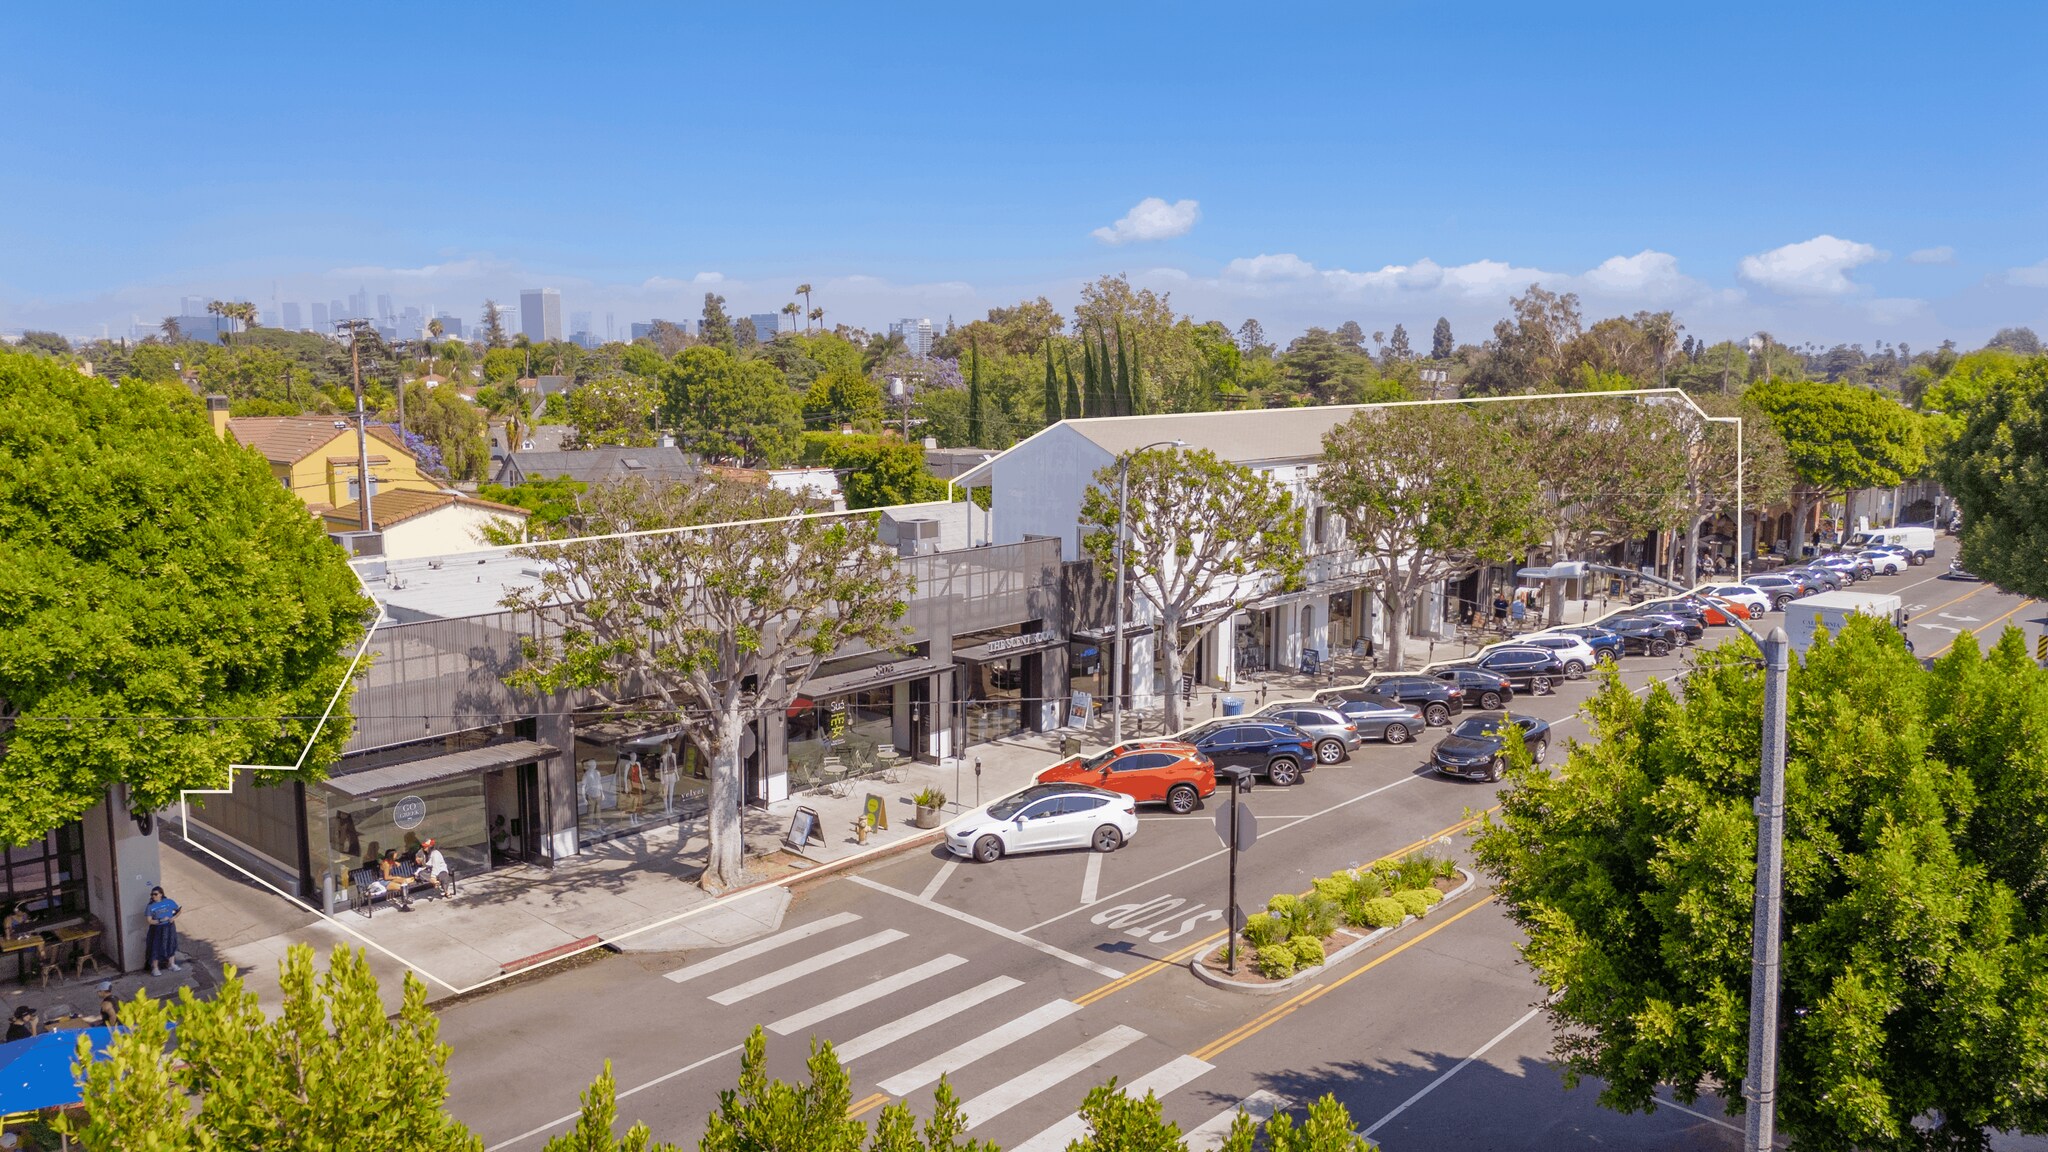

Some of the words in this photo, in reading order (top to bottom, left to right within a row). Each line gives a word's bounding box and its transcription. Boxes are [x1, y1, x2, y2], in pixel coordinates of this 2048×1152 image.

[1802, 619, 1841, 627] CALIORNIA
[988, 640, 1005, 652] THE
[1006, 634, 1030, 648] SCENT
[681, 788, 705, 799] velvet
[402, 802, 417, 812] GO
[1090, 893, 1223, 943] STOP
